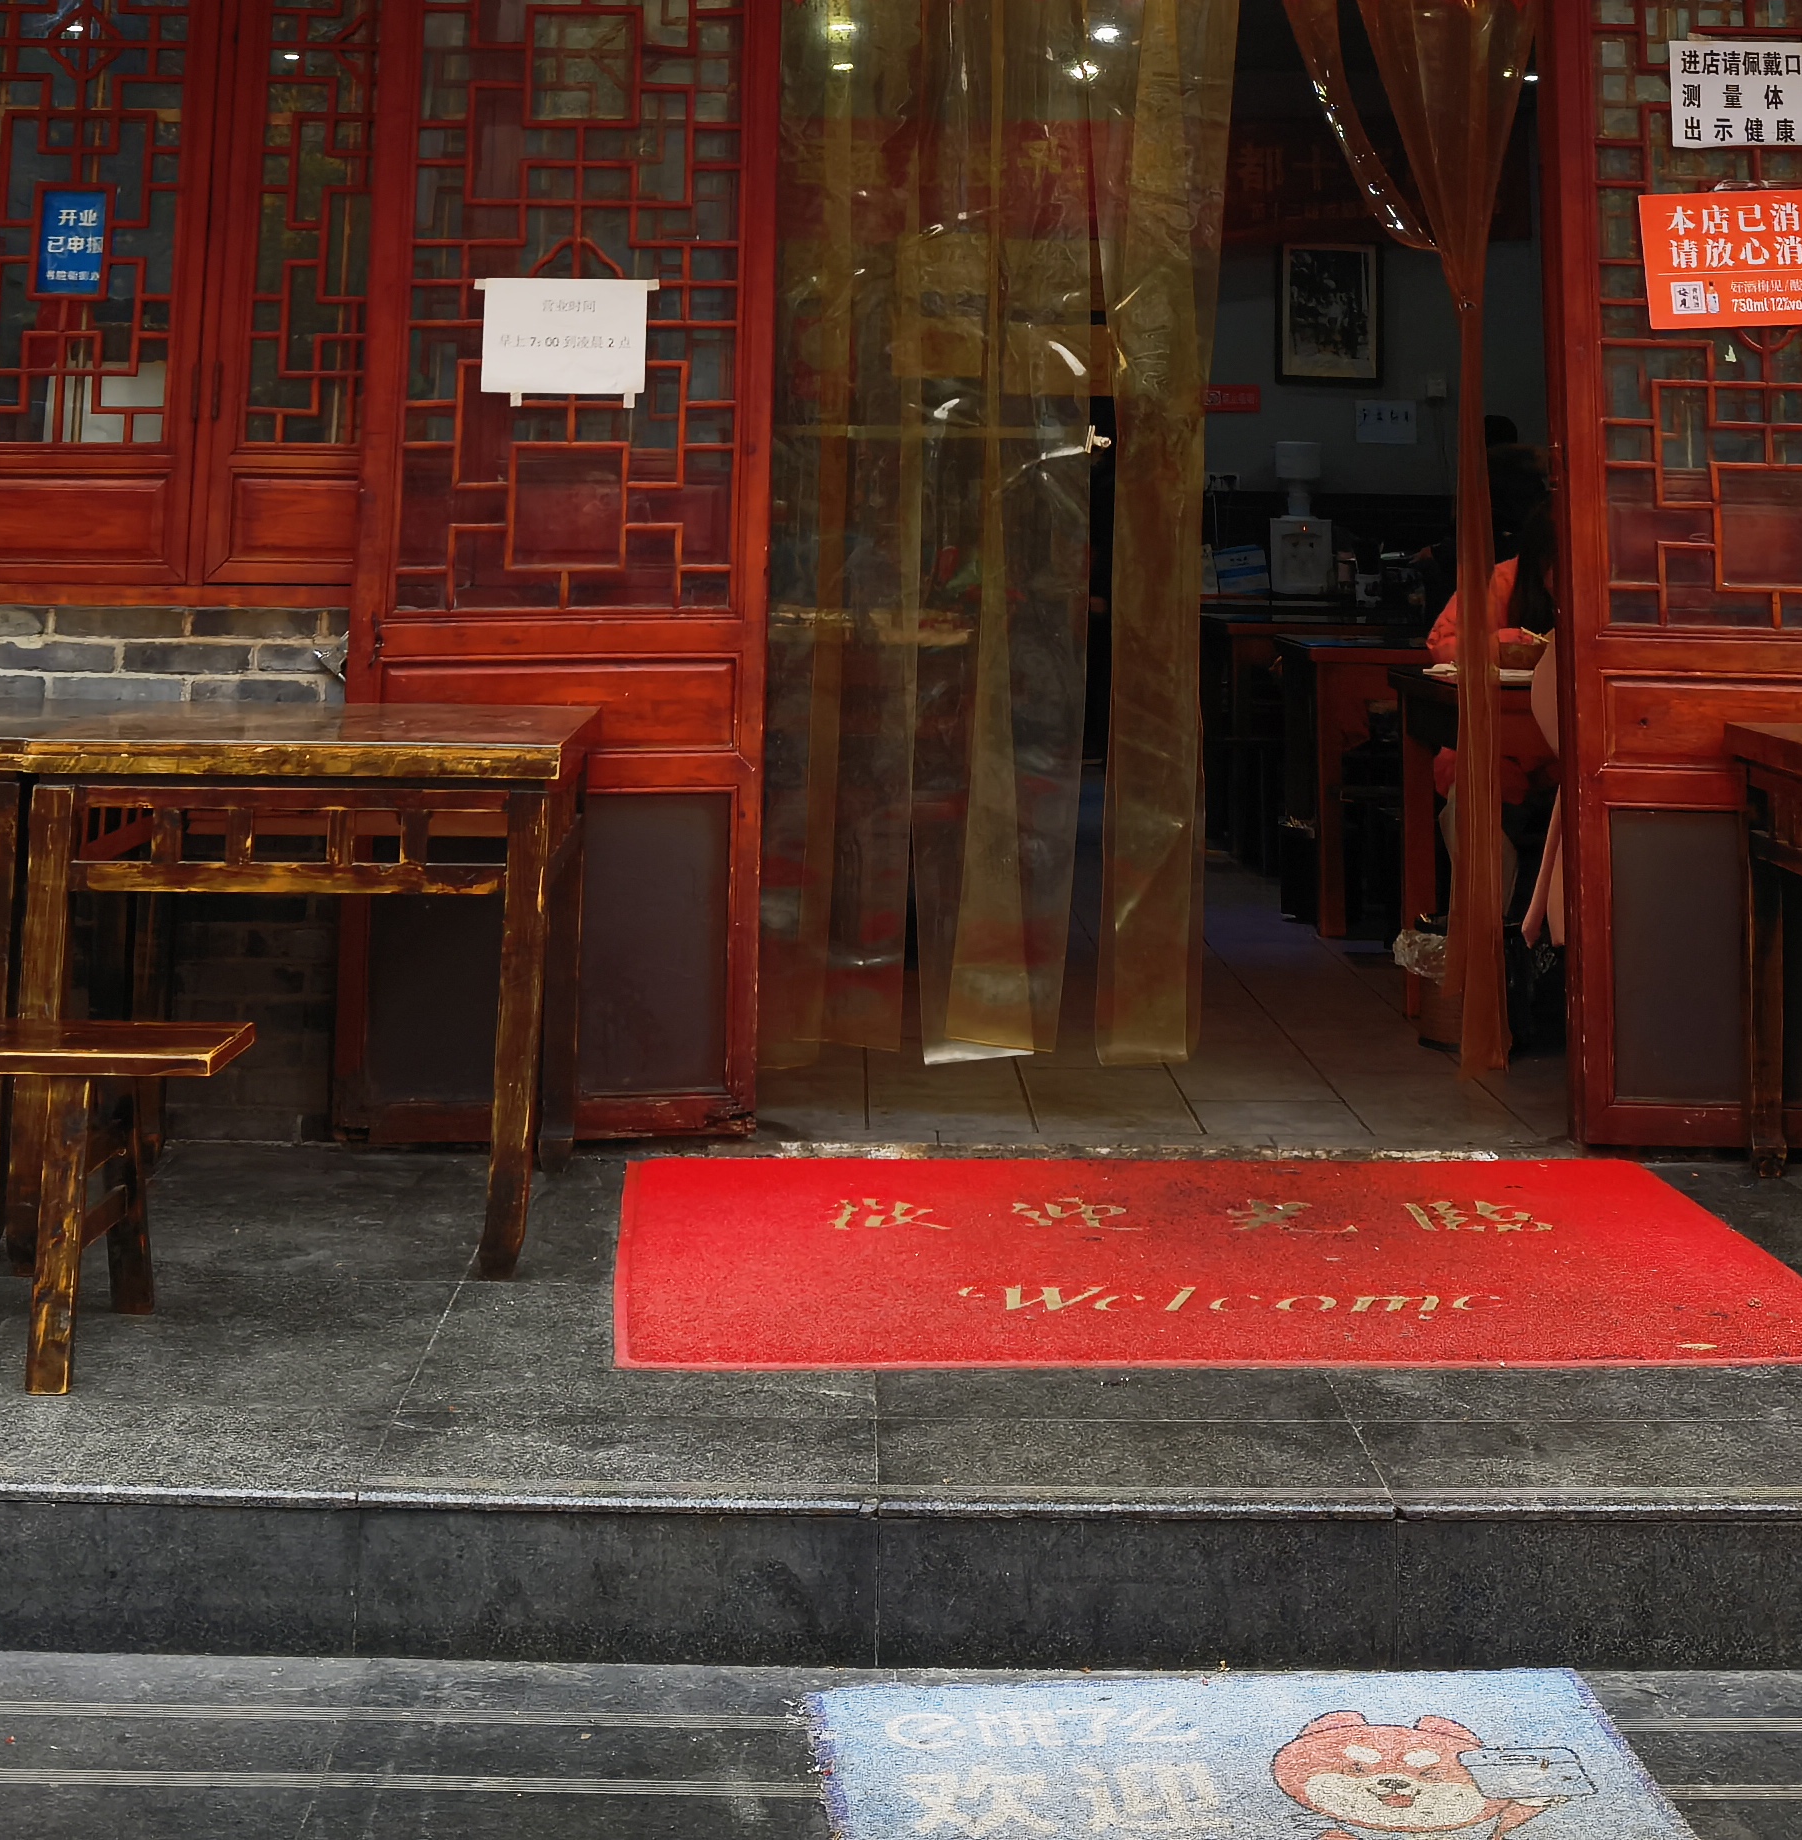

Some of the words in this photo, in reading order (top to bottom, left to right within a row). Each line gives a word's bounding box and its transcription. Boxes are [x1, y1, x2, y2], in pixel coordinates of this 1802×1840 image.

[57, 210, 98, 227] 开业
[46, 233, 105, 255] 已申报
[541, 300, 596, 313] 营业时间
[958, 1284, 1502, 1313] Welcome
[902, 1763, 1233, 1836] 欢迎
